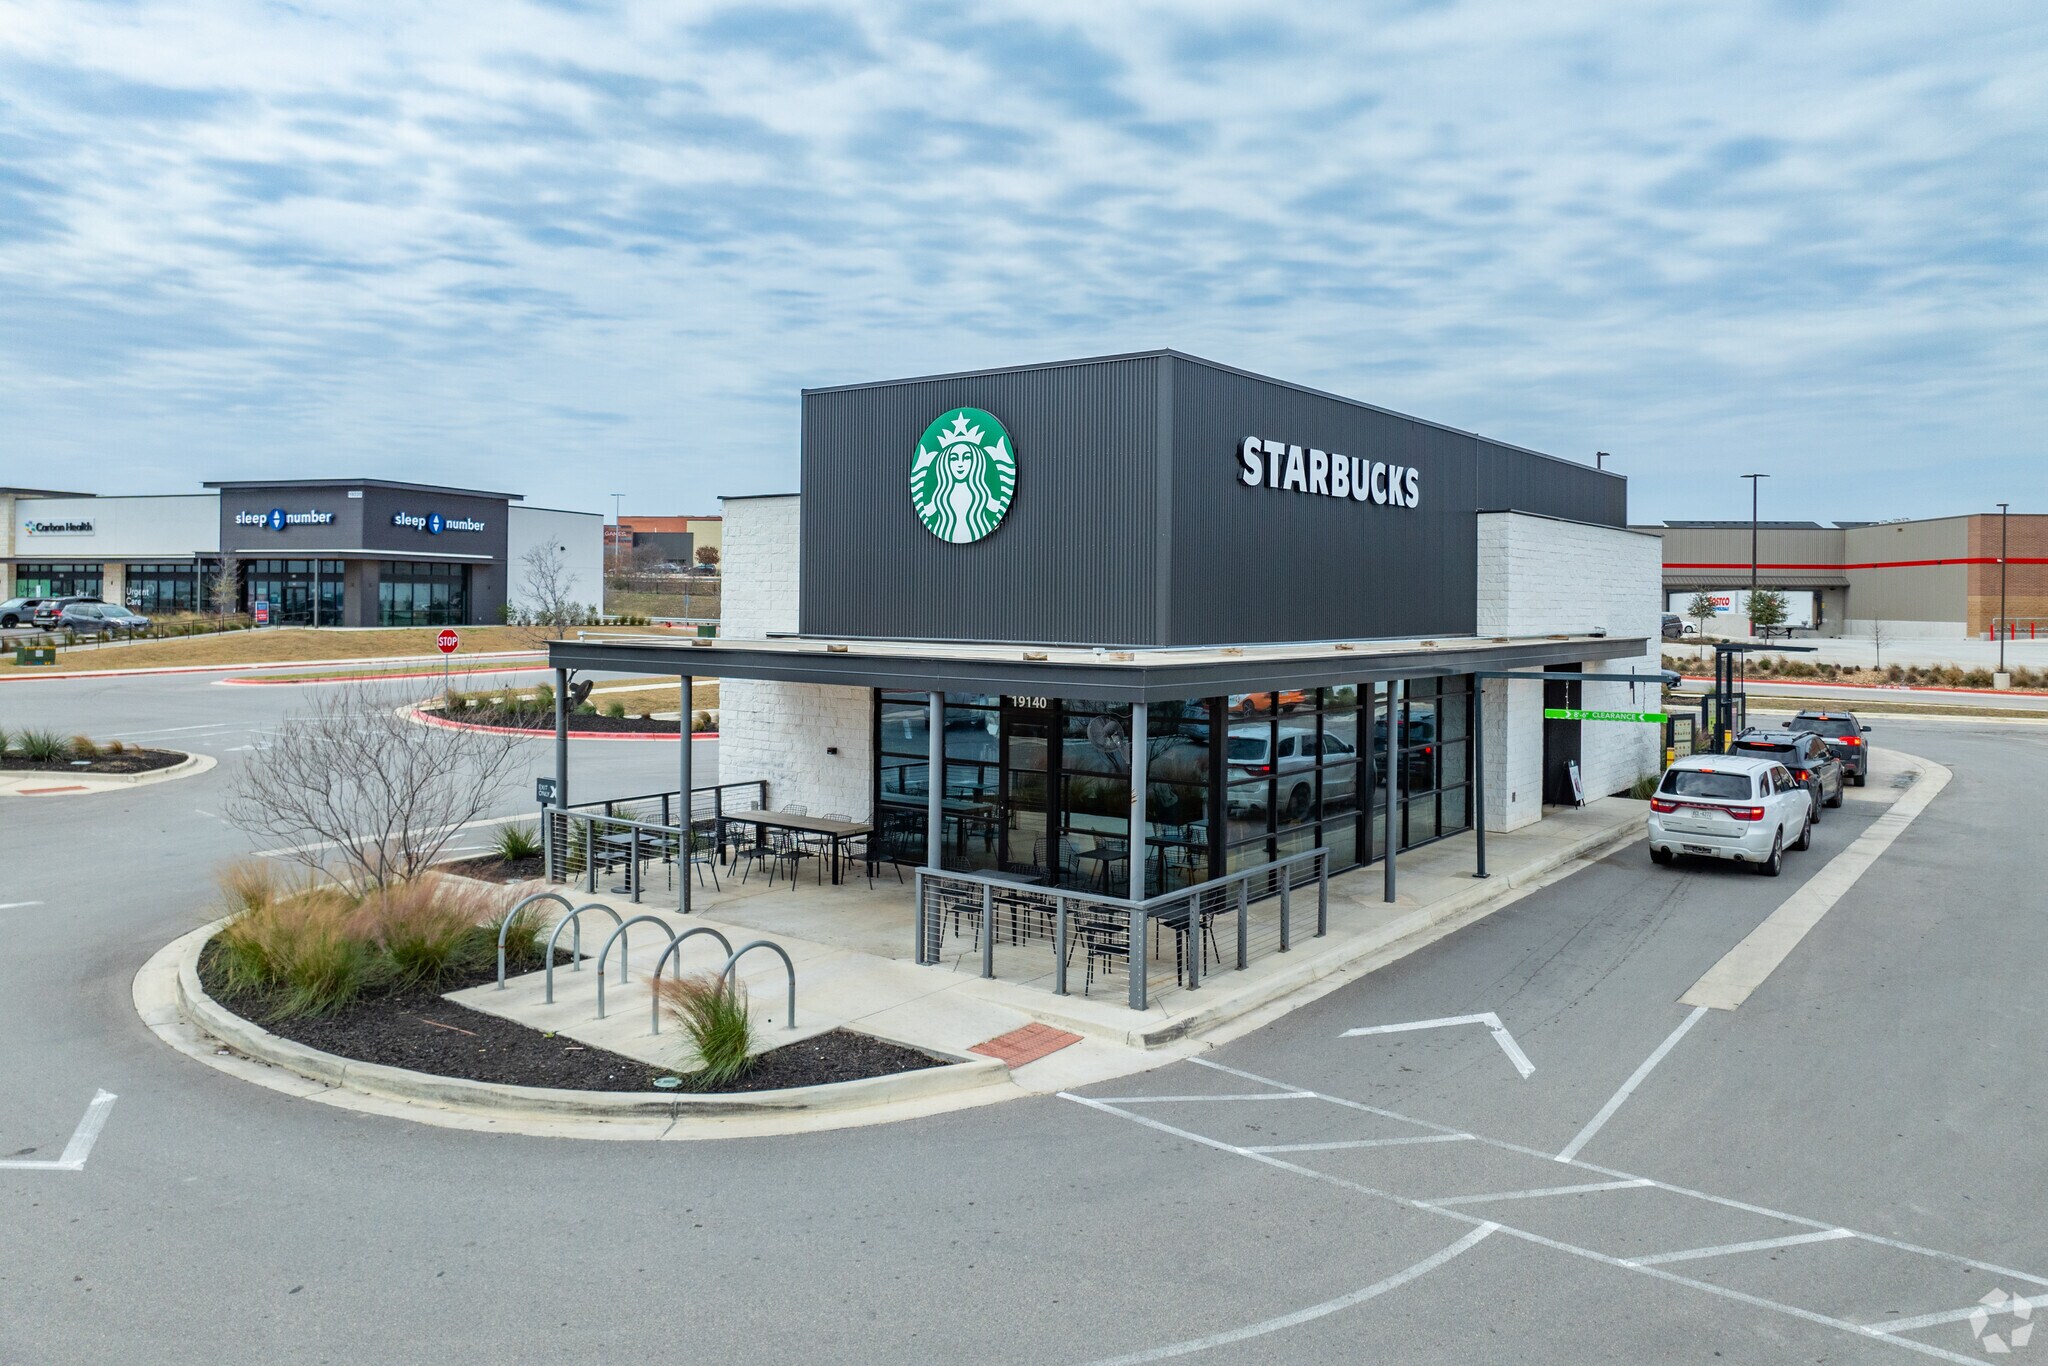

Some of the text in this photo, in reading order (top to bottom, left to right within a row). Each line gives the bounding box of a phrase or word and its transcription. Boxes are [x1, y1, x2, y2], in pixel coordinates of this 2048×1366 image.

[1239, 435, 1419, 508] STARBUCKS
[235, 509, 333, 528] sleep number
[394, 511, 485, 532] sleep number
[35, 521, 93, 532] Carbon Health
[125, 596, 142, 606] Care
[438, 636, 458, 647] STOP
[1011, 695, 1047, 709] 19140
[1591, 711, 1636, 720] CLEARANCE
